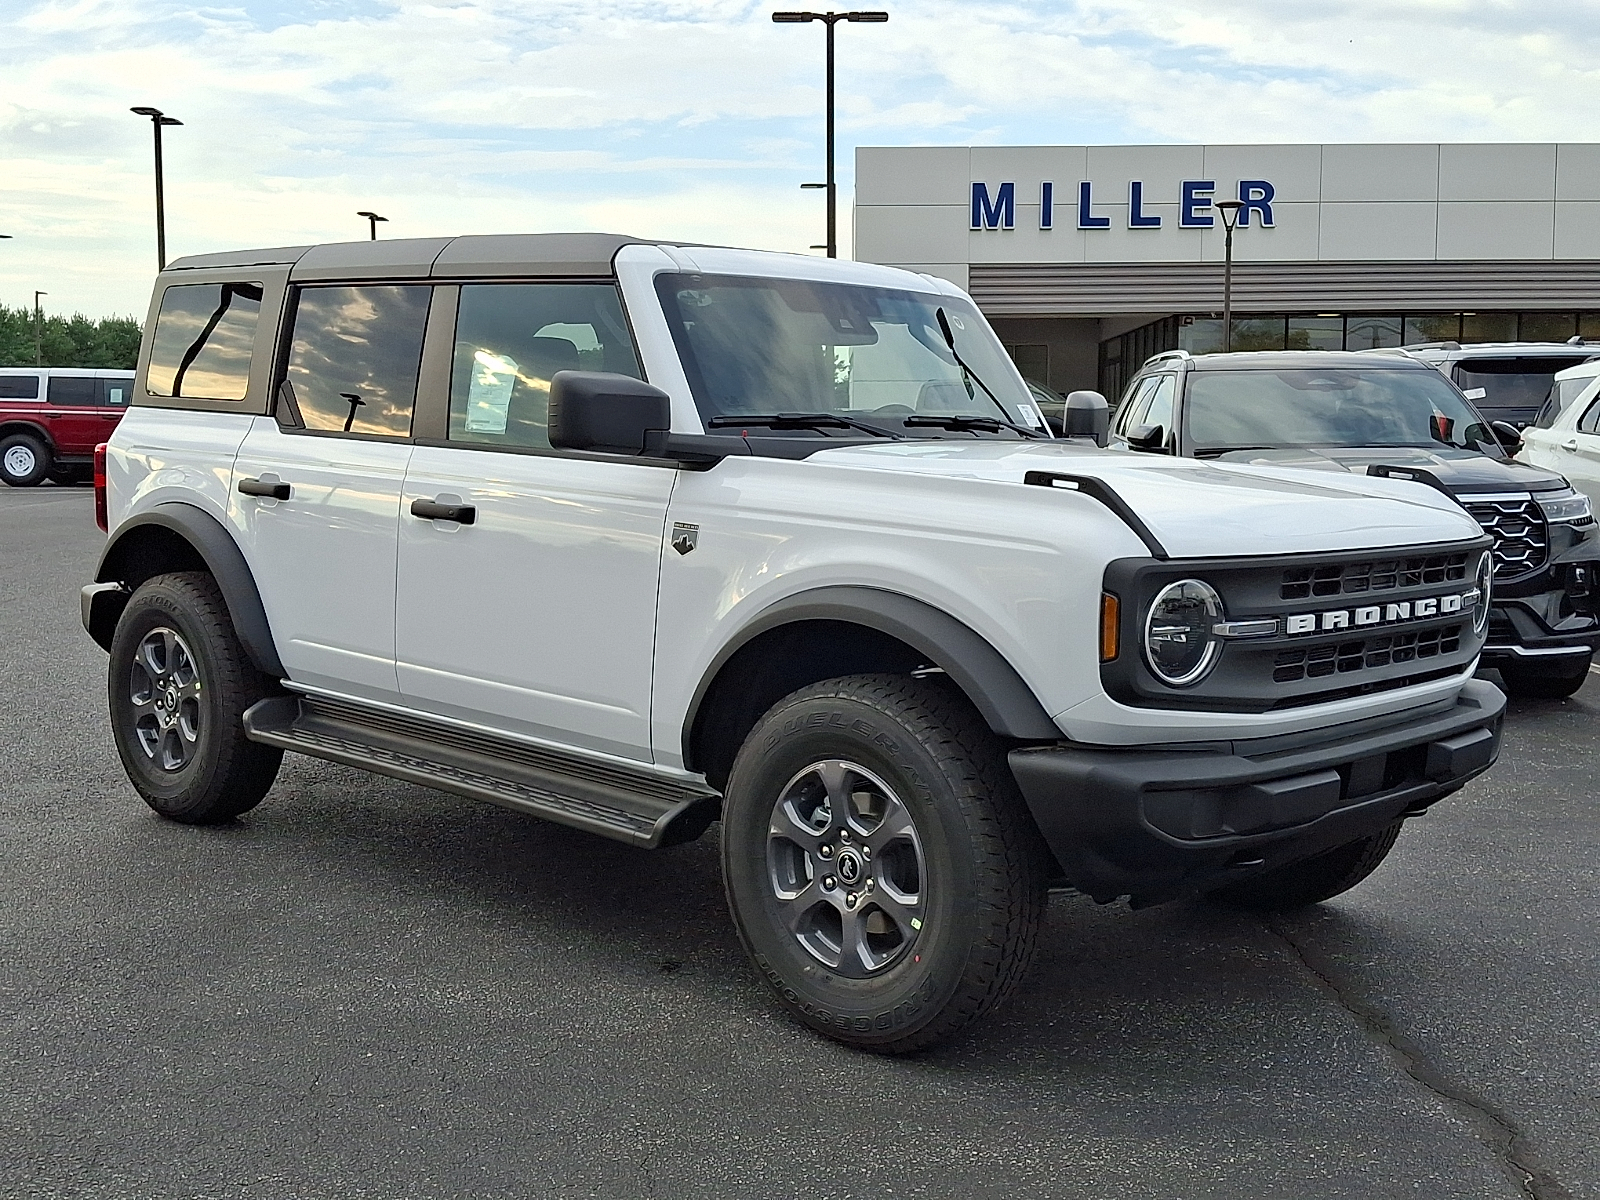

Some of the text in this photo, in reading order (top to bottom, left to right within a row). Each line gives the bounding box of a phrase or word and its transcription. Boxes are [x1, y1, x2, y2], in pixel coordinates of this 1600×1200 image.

[970, 181, 1276, 229] MILLER
[1287, 594, 1461, 634] BRONCO
[763, 711, 900, 757] DUELER
